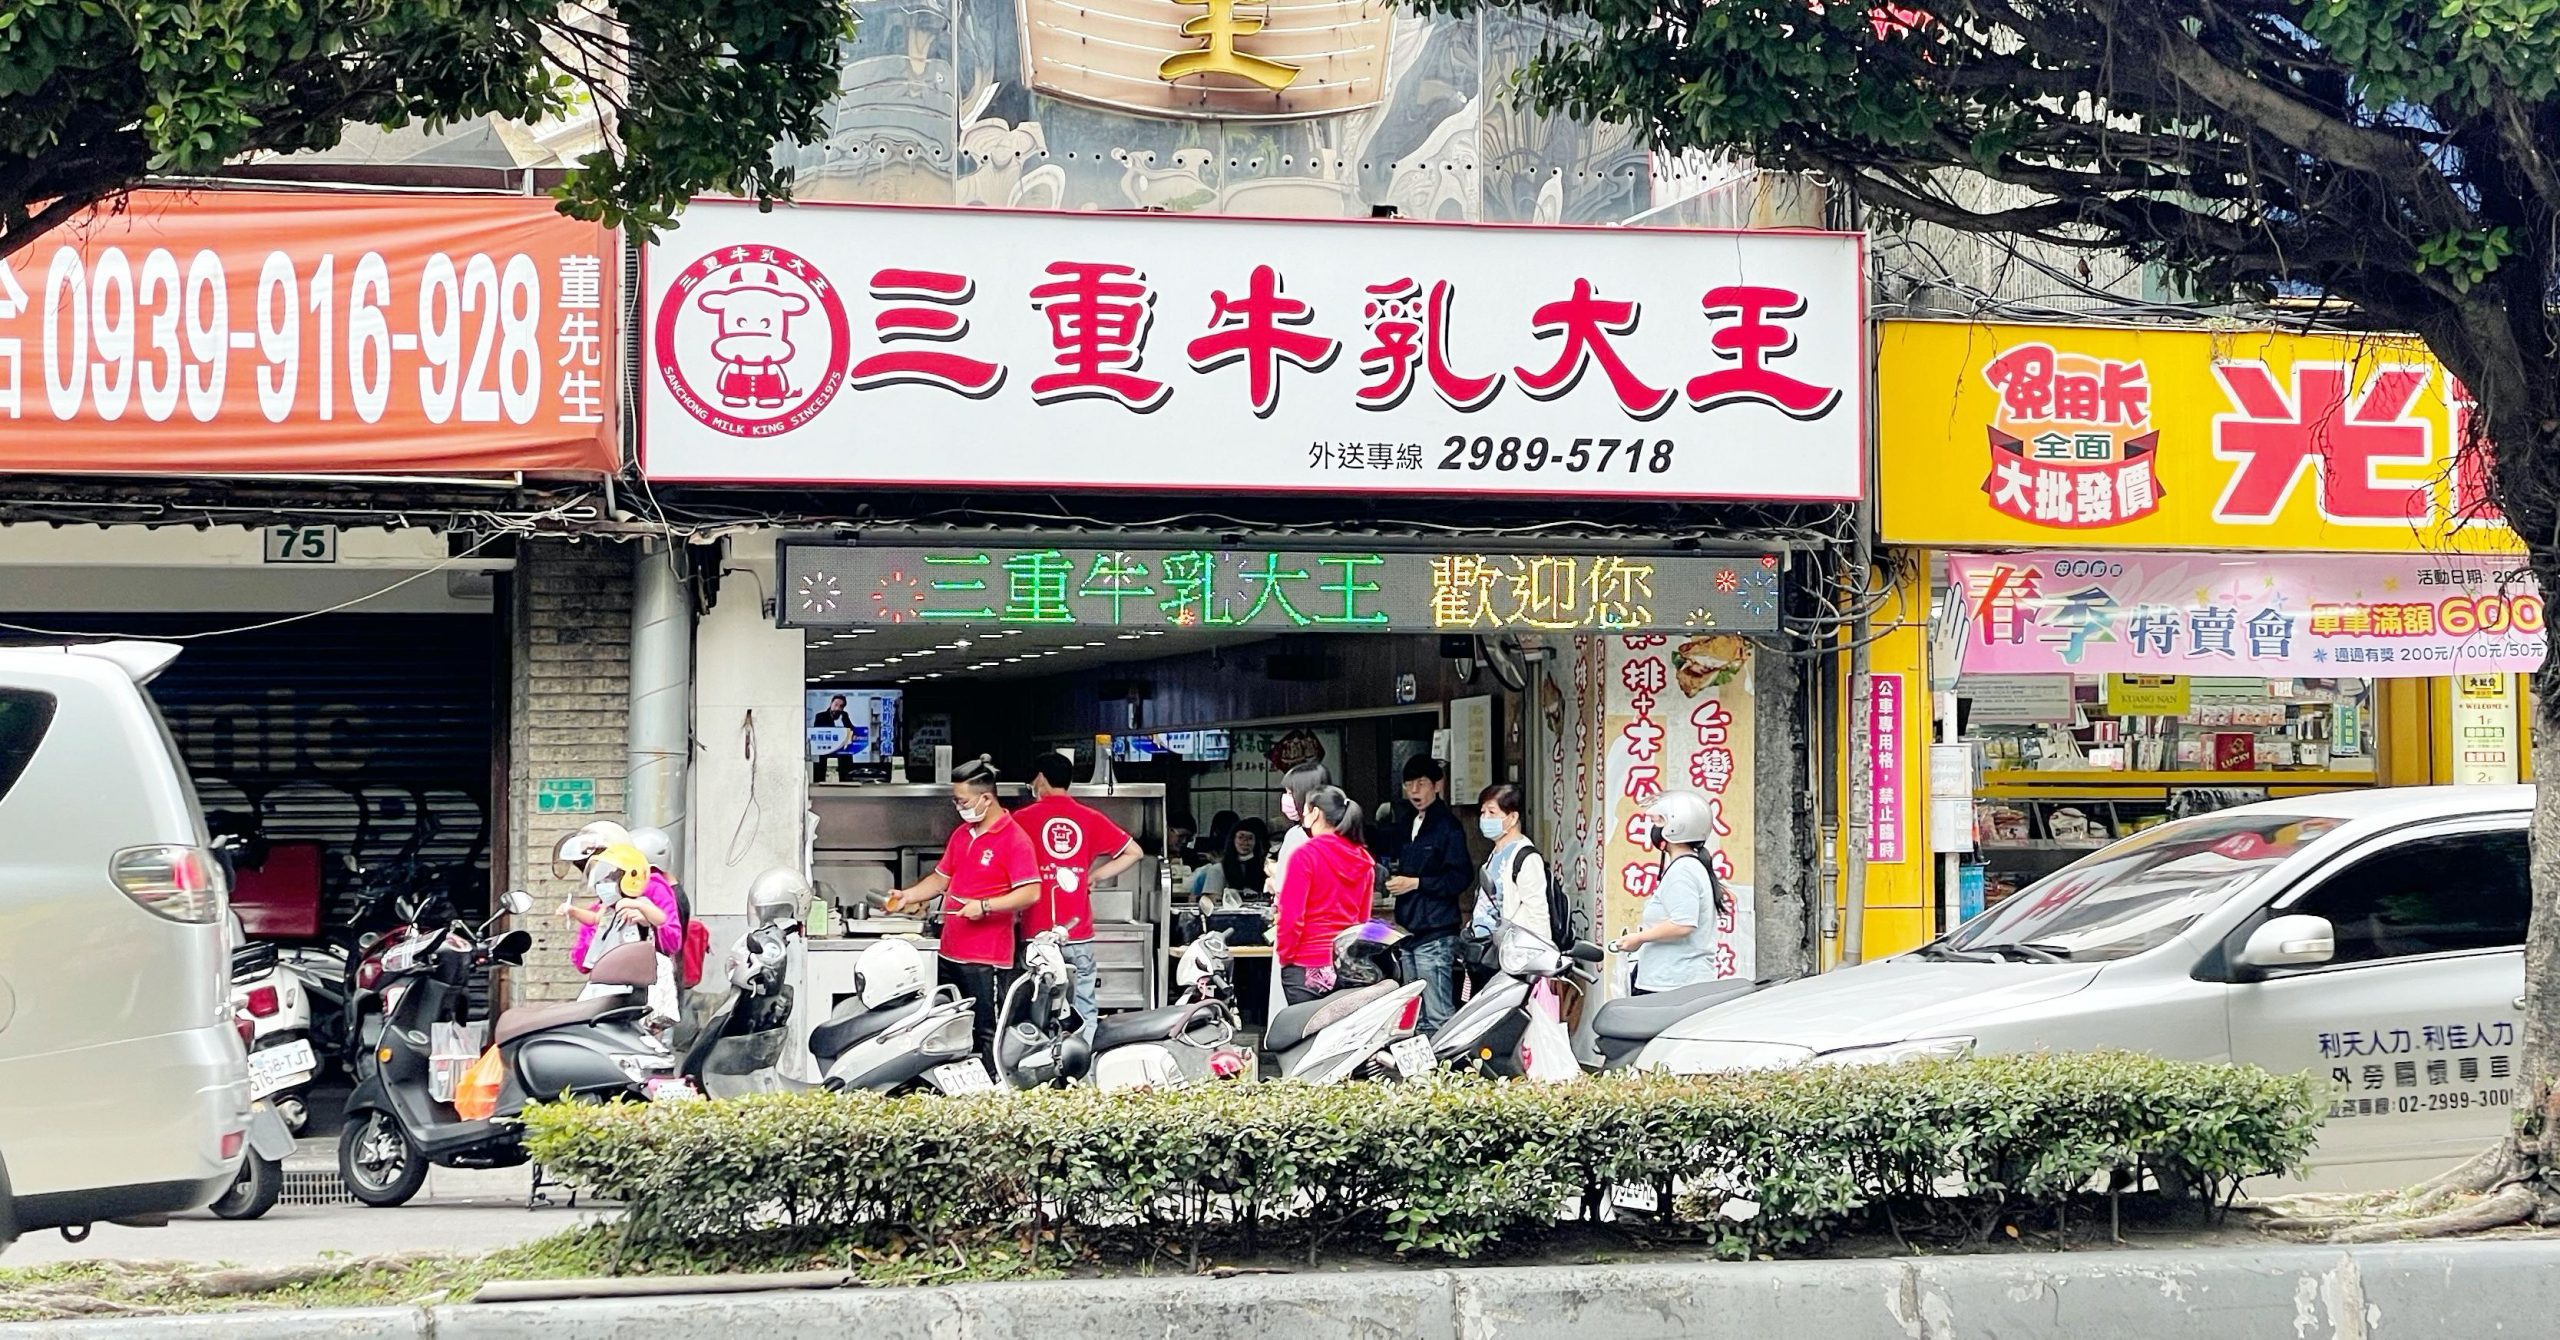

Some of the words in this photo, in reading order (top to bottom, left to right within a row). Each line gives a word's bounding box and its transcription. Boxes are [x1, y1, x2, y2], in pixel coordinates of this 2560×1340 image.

[679, 246, 828, 298] 三重牛乳大王
[43, 246, 541, 425] 0939-916-928
[559, 254, 603, 424] 董先生
[851, 261, 1841, 418] 三重牛乳大王
[664, 365, 708, 419] SANCHONG
[712, 416, 745, 435] MILK
[752, 423, 785, 436] KING
[1308, 441, 1424, 471] 外送專線
[1438, 434, 1675, 475] 2989-5718
[2033, 432, 2112, 460] 全面
[2213, 364, 2508, 525] 光
[1993, 459, 2155, 523] 大批發價
[275, 530, 326, 559] 75
[919, 552, 1390, 626] 三重牛乳大王
[1428, 553, 1656, 627] 歡迎您
[2417, 569, 2488, 586] 活動日期:
[1965, 563, 2297, 666] 春季特賣會
[2311, 605, 2436, 636] 單筆滿額
[2440, 594, 2545, 637] 600
[2220, 751, 2251, 769] LUCKY
